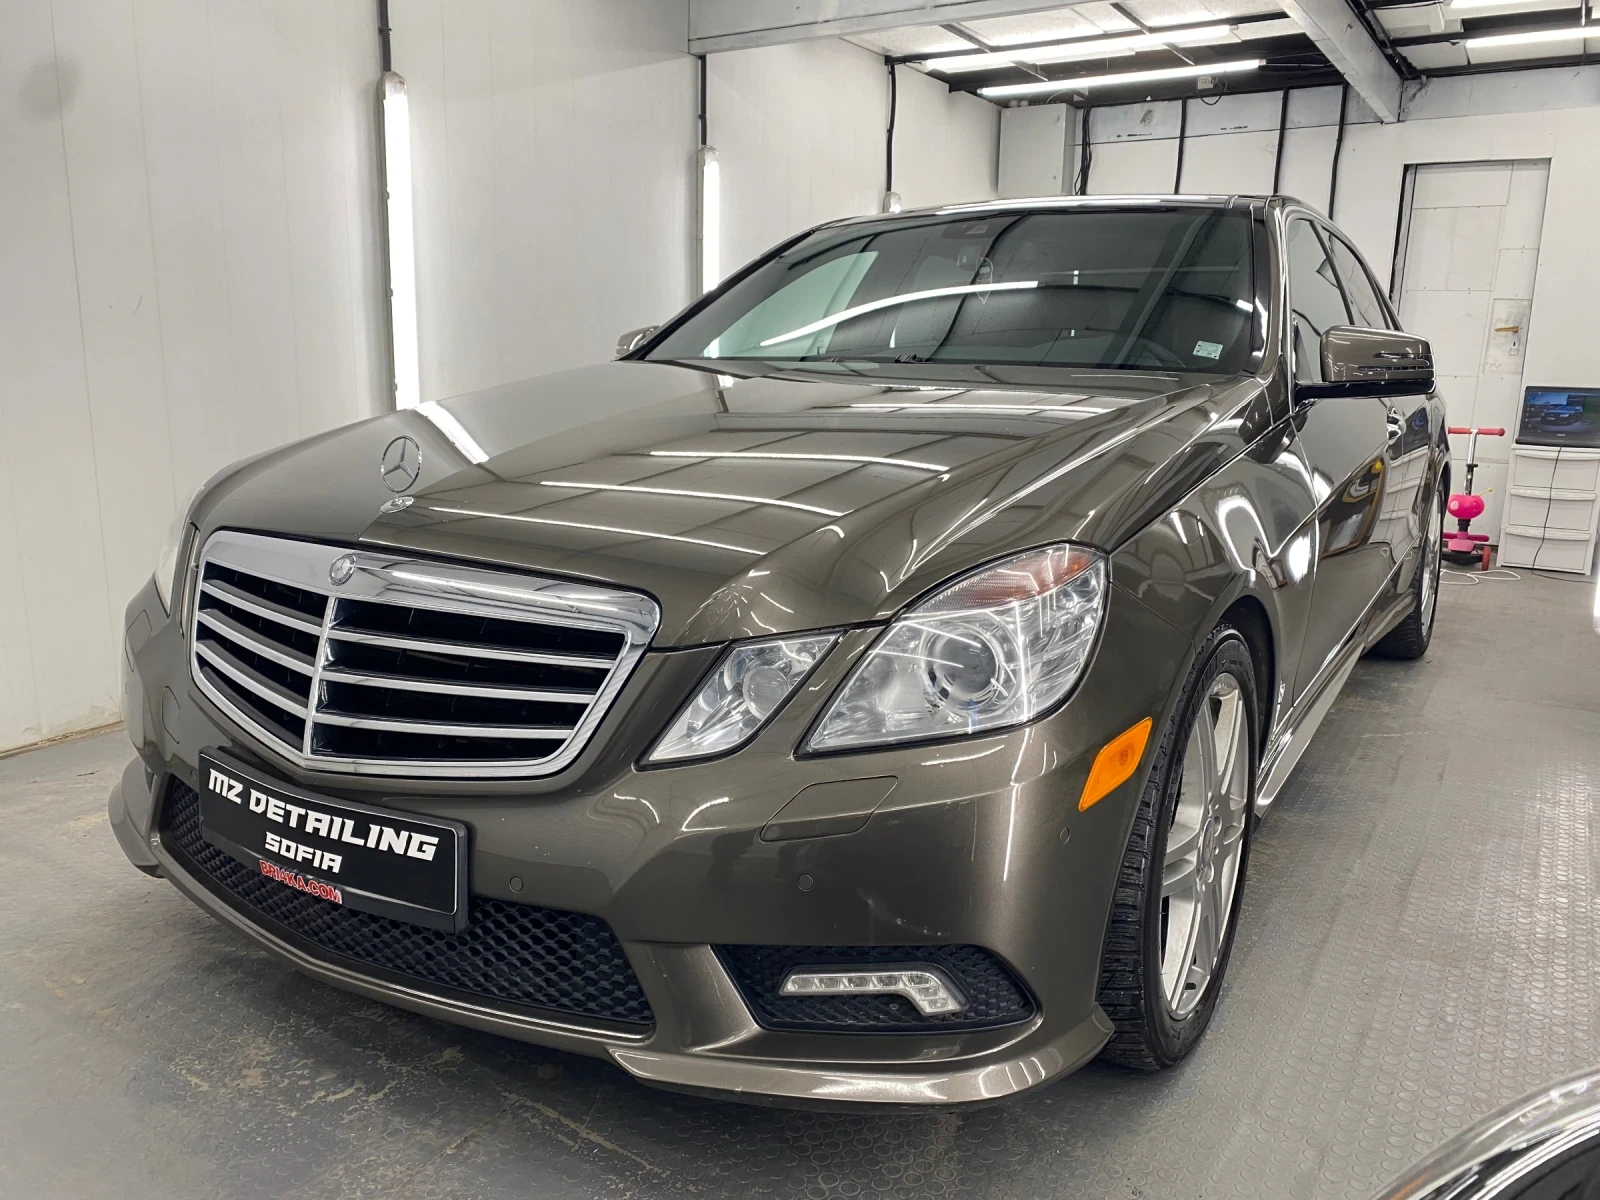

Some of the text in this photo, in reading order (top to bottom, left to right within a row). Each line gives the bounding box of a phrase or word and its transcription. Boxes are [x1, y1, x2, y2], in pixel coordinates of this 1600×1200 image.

[208, 768, 440, 862] MZ DETAILING
[265, 831, 343, 874] SOFIA
